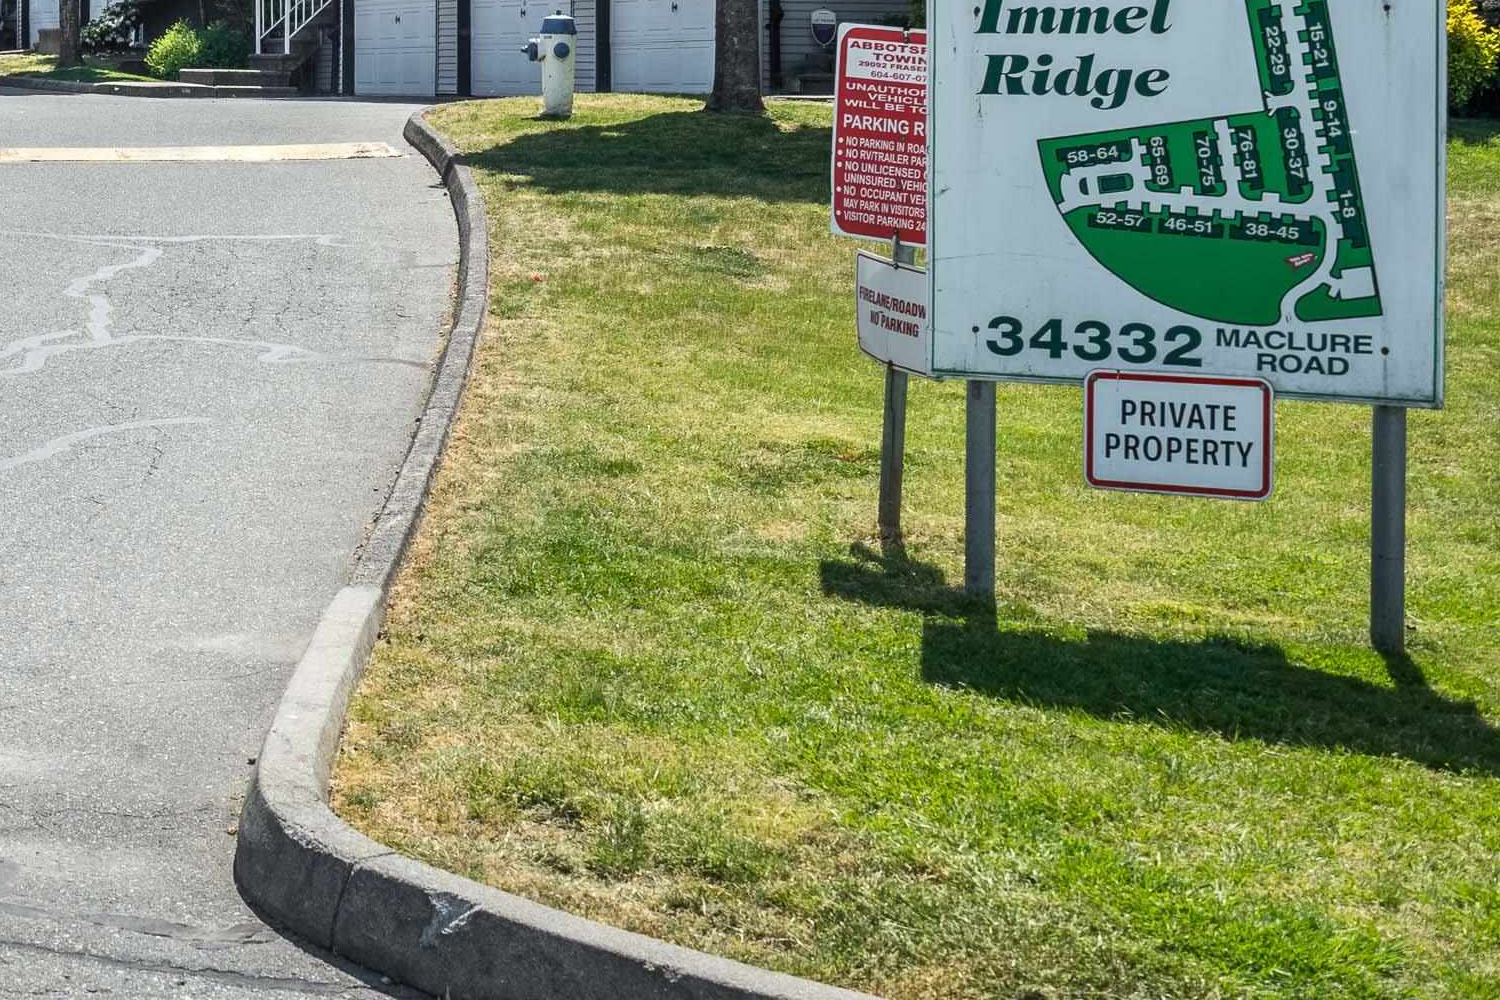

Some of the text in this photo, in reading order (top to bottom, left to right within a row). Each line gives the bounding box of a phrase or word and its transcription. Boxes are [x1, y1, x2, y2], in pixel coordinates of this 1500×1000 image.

[1265, 25, 1286, 76] 22-29
[1308, 21, 1330, 68] 15-21
[975, 53, 1170, 110] Ridge
[844, 98, 880, 110] WILL
[884, 103, 905, 113] BE
[843, 113, 909, 135] PARKING
[1323, 99, 1343, 138] 9-14
[845, 136, 928, 155] NO PARKING IN ROA
[845, 148, 858, 159] NO
[860, 150, 909, 165] RV/TRAILER
[1066, 145, 1119, 164] 58-64
[1238, 129, 1258, 180] 76-81
[1283, 127, 1304, 179] 30-37
[844, 161, 859, 172] NO
[861, 162, 921, 179] UNLICENSED
[1149, 136, 1170, 187] 65-69
[1195, 136, 1216, 187] 70-75
[844, 172, 896, 189] UNINSURED
[843, 185, 856, 196] NO
[860, 187, 909, 203] OCCUPANT
[1339, 189, 1356, 219] 1-8
[843, 198, 925, 218] MAY PARK IN VISITORS
[843, 210, 875, 224] VISITOR
[876, 216, 914, 231] PARKING
[1095, 211, 1145, 228] 52-57
[1163, 217, 1213, 234] 46-51
[1245, 222, 1300, 240] 38-45
[869, 310, 919, 338] NO PARKING
[985, 315, 1204, 368] 34332
[1215, 328, 1374, 356] MACLURE
[1255, 353, 1350, 376] ROAD
[1120, 399, 1237, 433] PRIVATE
[1104, 433, 1254, 469] PROPERTY
